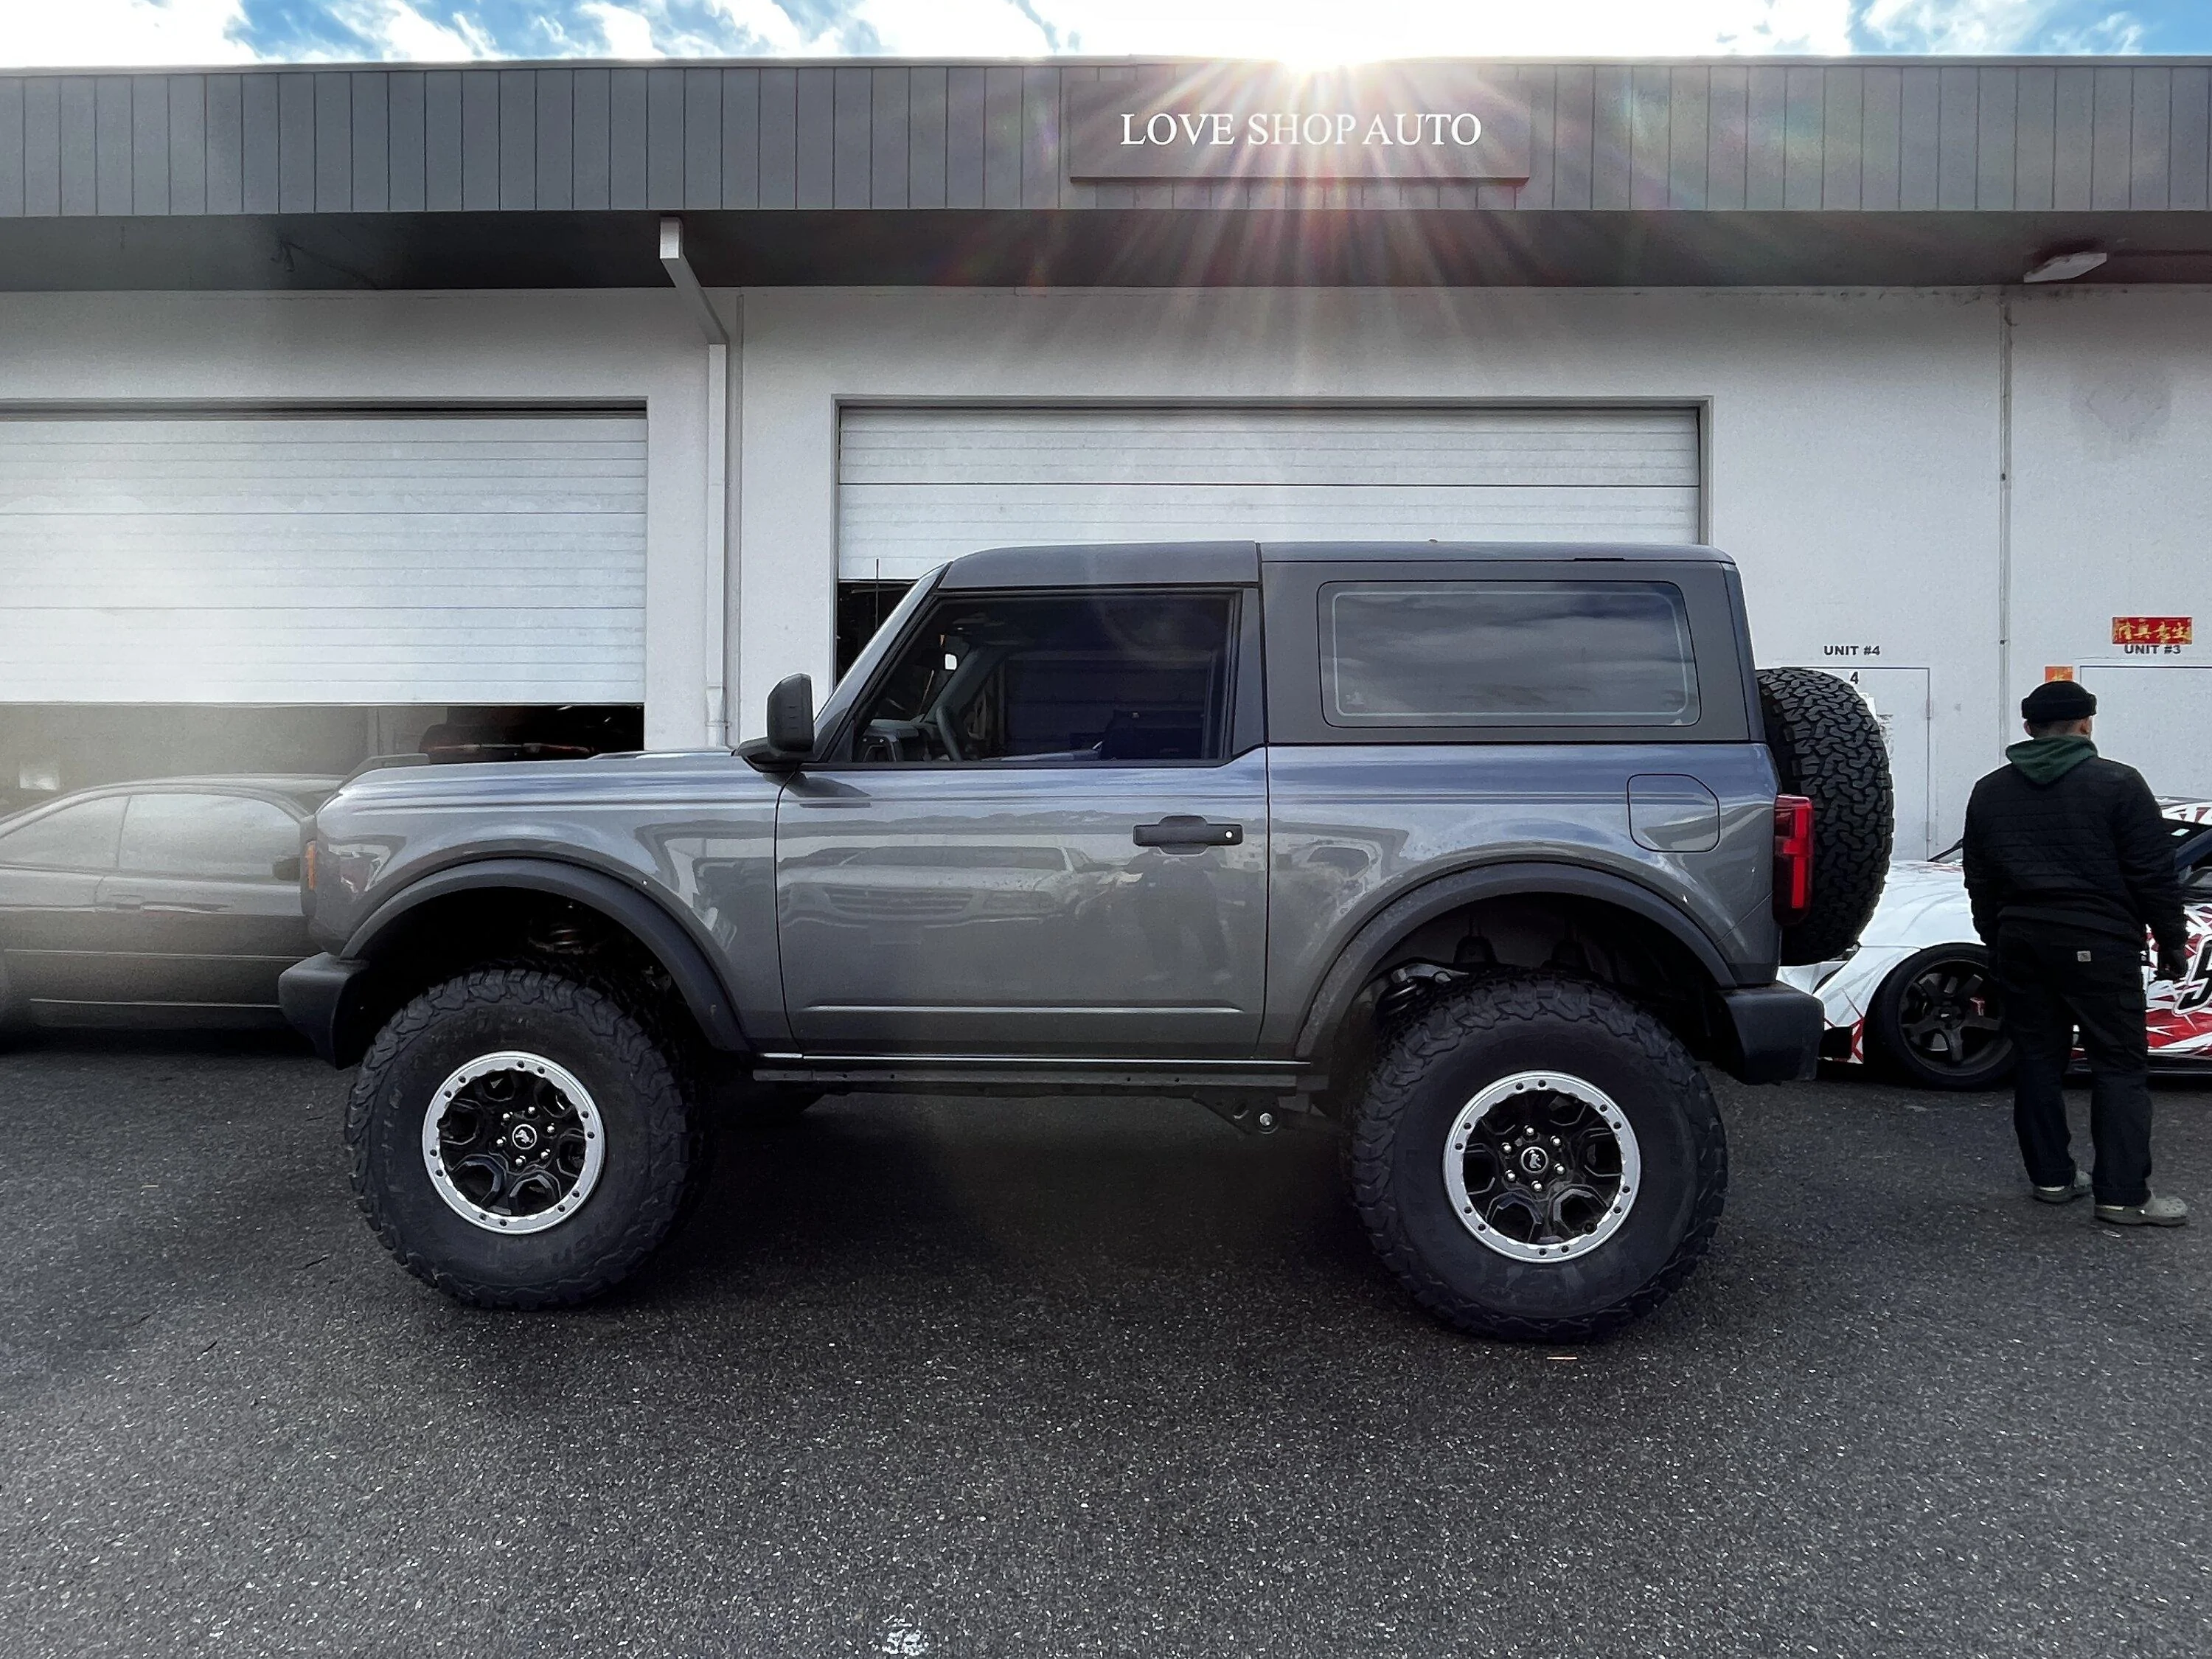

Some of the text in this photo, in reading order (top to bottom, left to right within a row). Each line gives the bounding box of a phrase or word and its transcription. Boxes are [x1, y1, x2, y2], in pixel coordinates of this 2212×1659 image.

[1121, 113, 1482, 145] LOVE SHOP AUTO
[1823, 645, 1880, 655] UNIT #4
[2124, 644, 2182, 655] UNIT #3
[1850, 671, 1860, 684] 4
